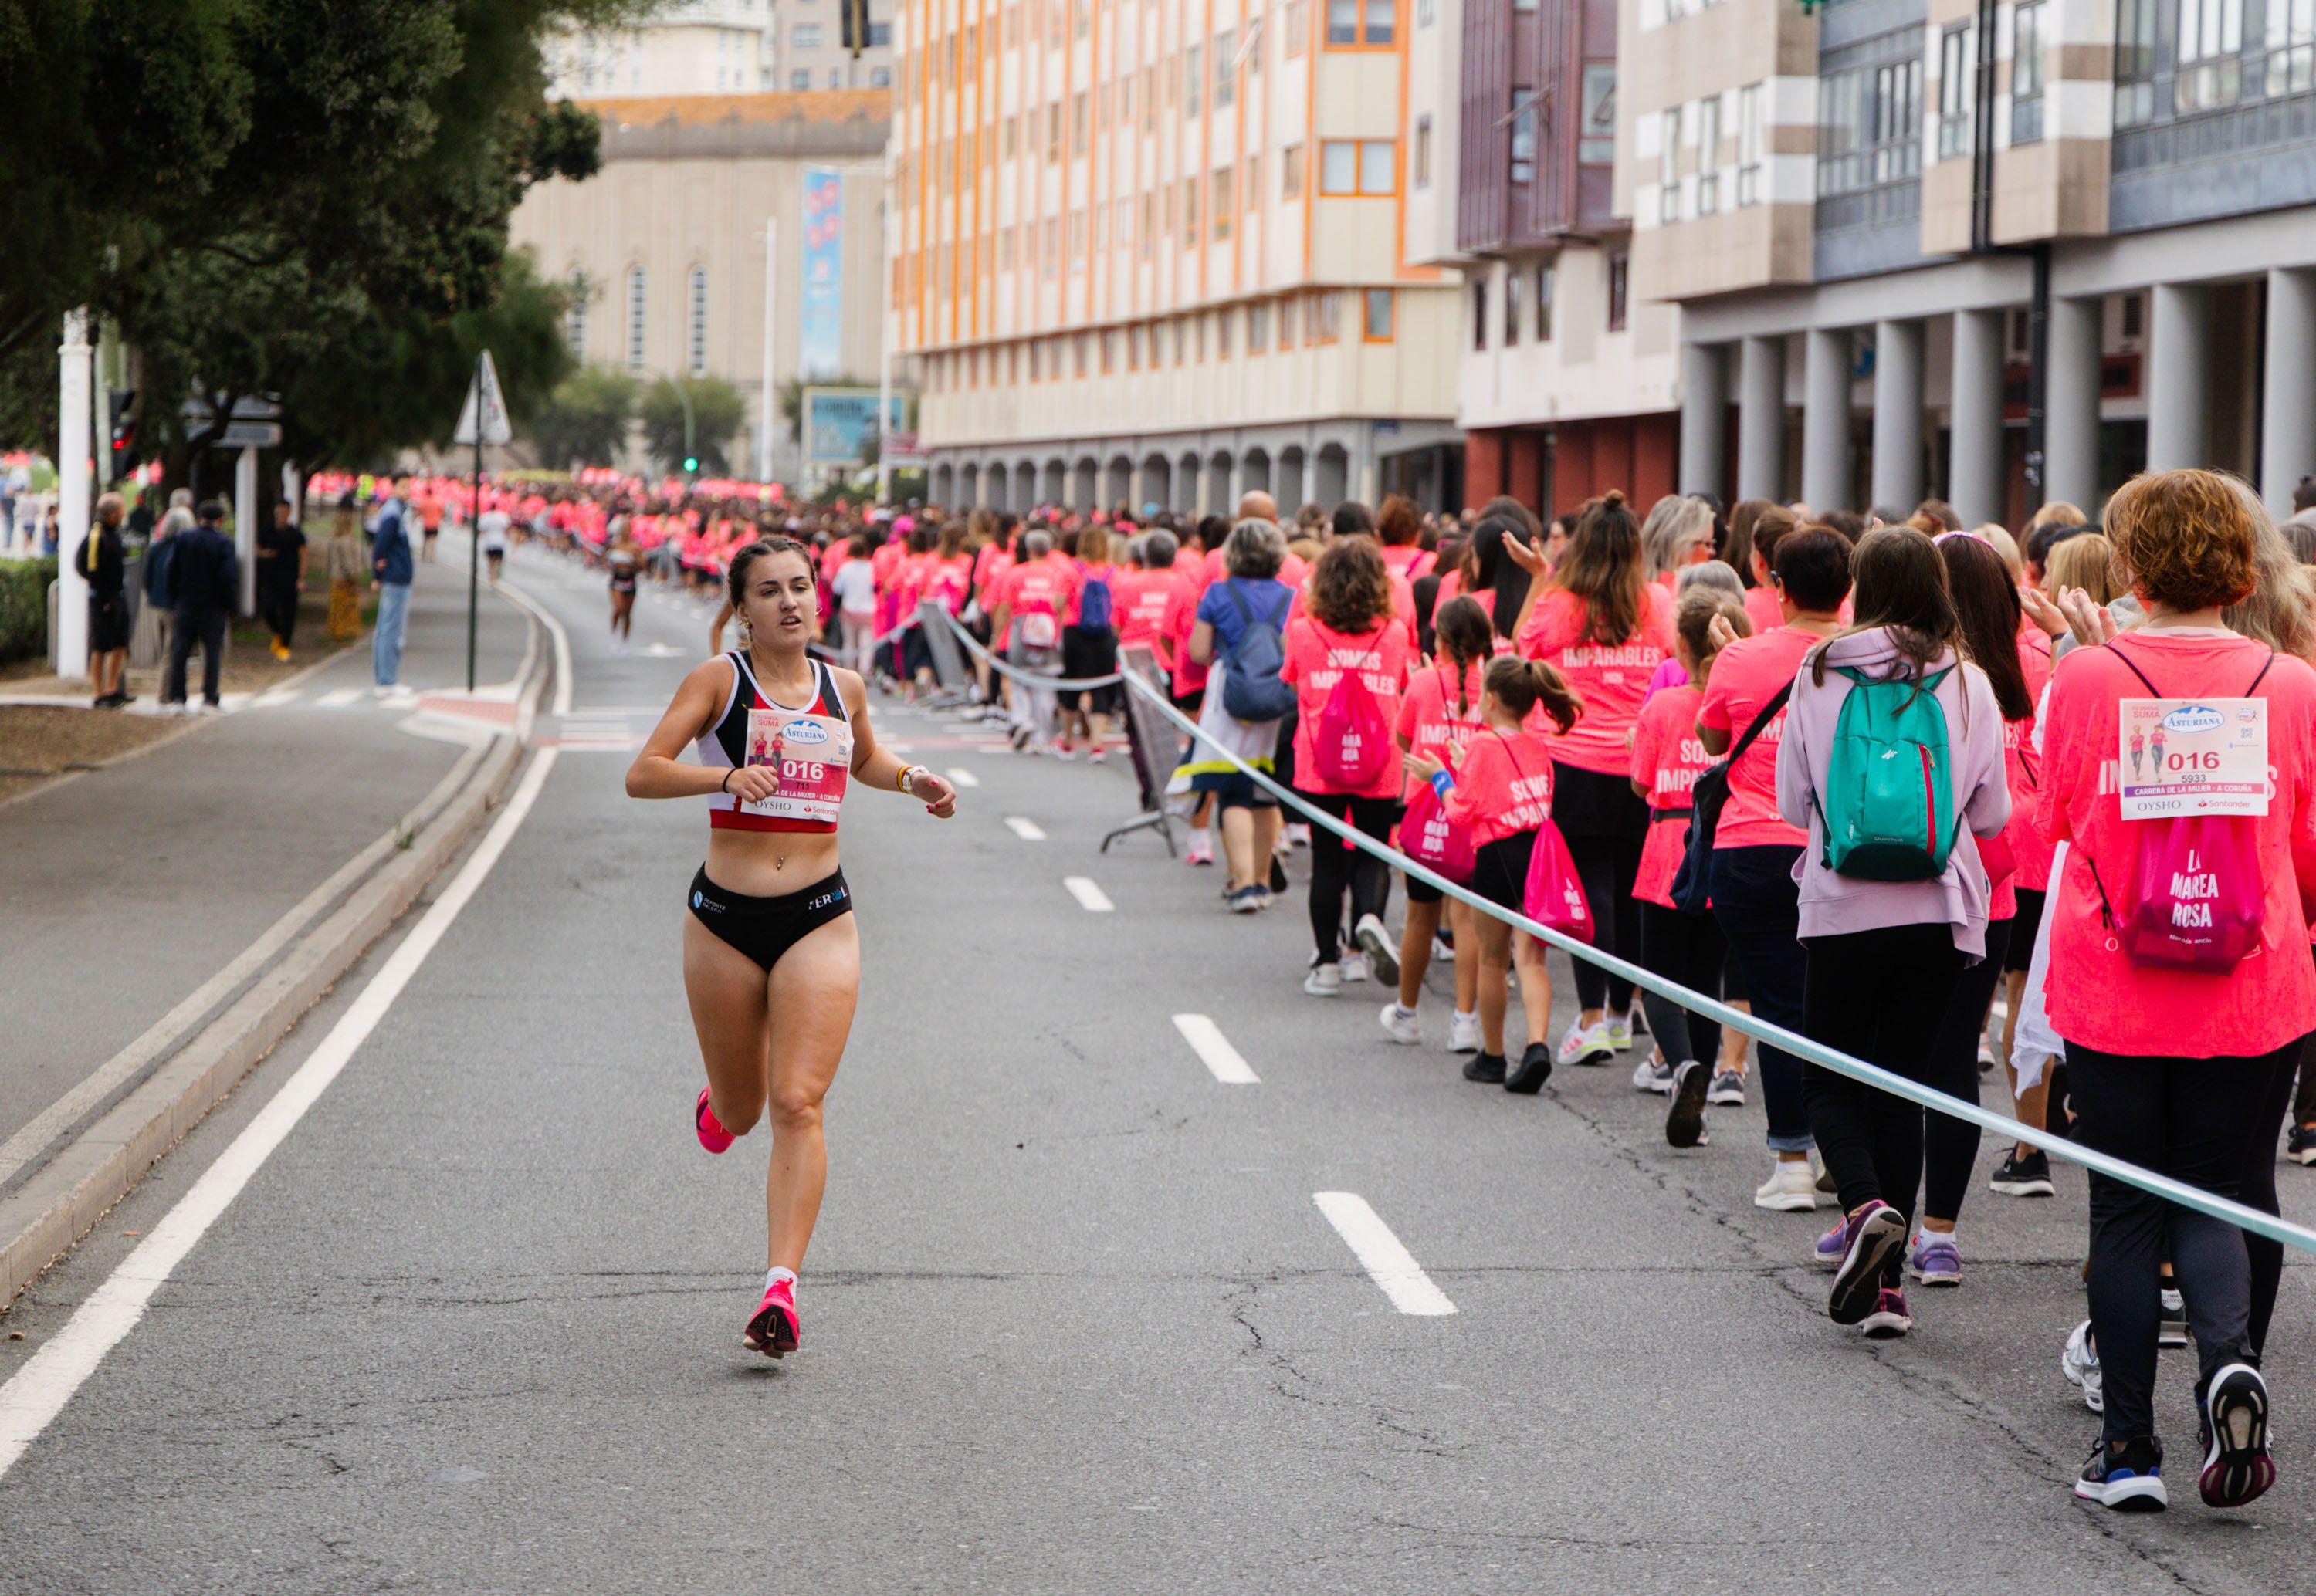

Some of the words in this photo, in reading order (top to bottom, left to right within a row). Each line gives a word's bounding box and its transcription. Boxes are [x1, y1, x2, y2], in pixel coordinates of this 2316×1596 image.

[1327, 649, 1382, 671] SOMOS
[1563, 646, 1660, 668] IMPARABLES
[782, 759, 824, 780] 016
[2167, 751, 2220, 771] 016
[2181, 773, 2206, 783] 5933
[2134, 787, 2165, 796] CARRERA
[2188, 785, 2211, 793] MUJER
[2224, 783, 2253, 792] CORUÑA
[756, 801, 791, 811] OYSHO
[2138, 800, 2181, 811] OYSHO
[2209, 800, 2251, 808] Santander
[2187, 849, 2202, 873] LA
[2169, 871, 2220, 900] MAREA
[2171, 902, 2213, 928] ROSA
